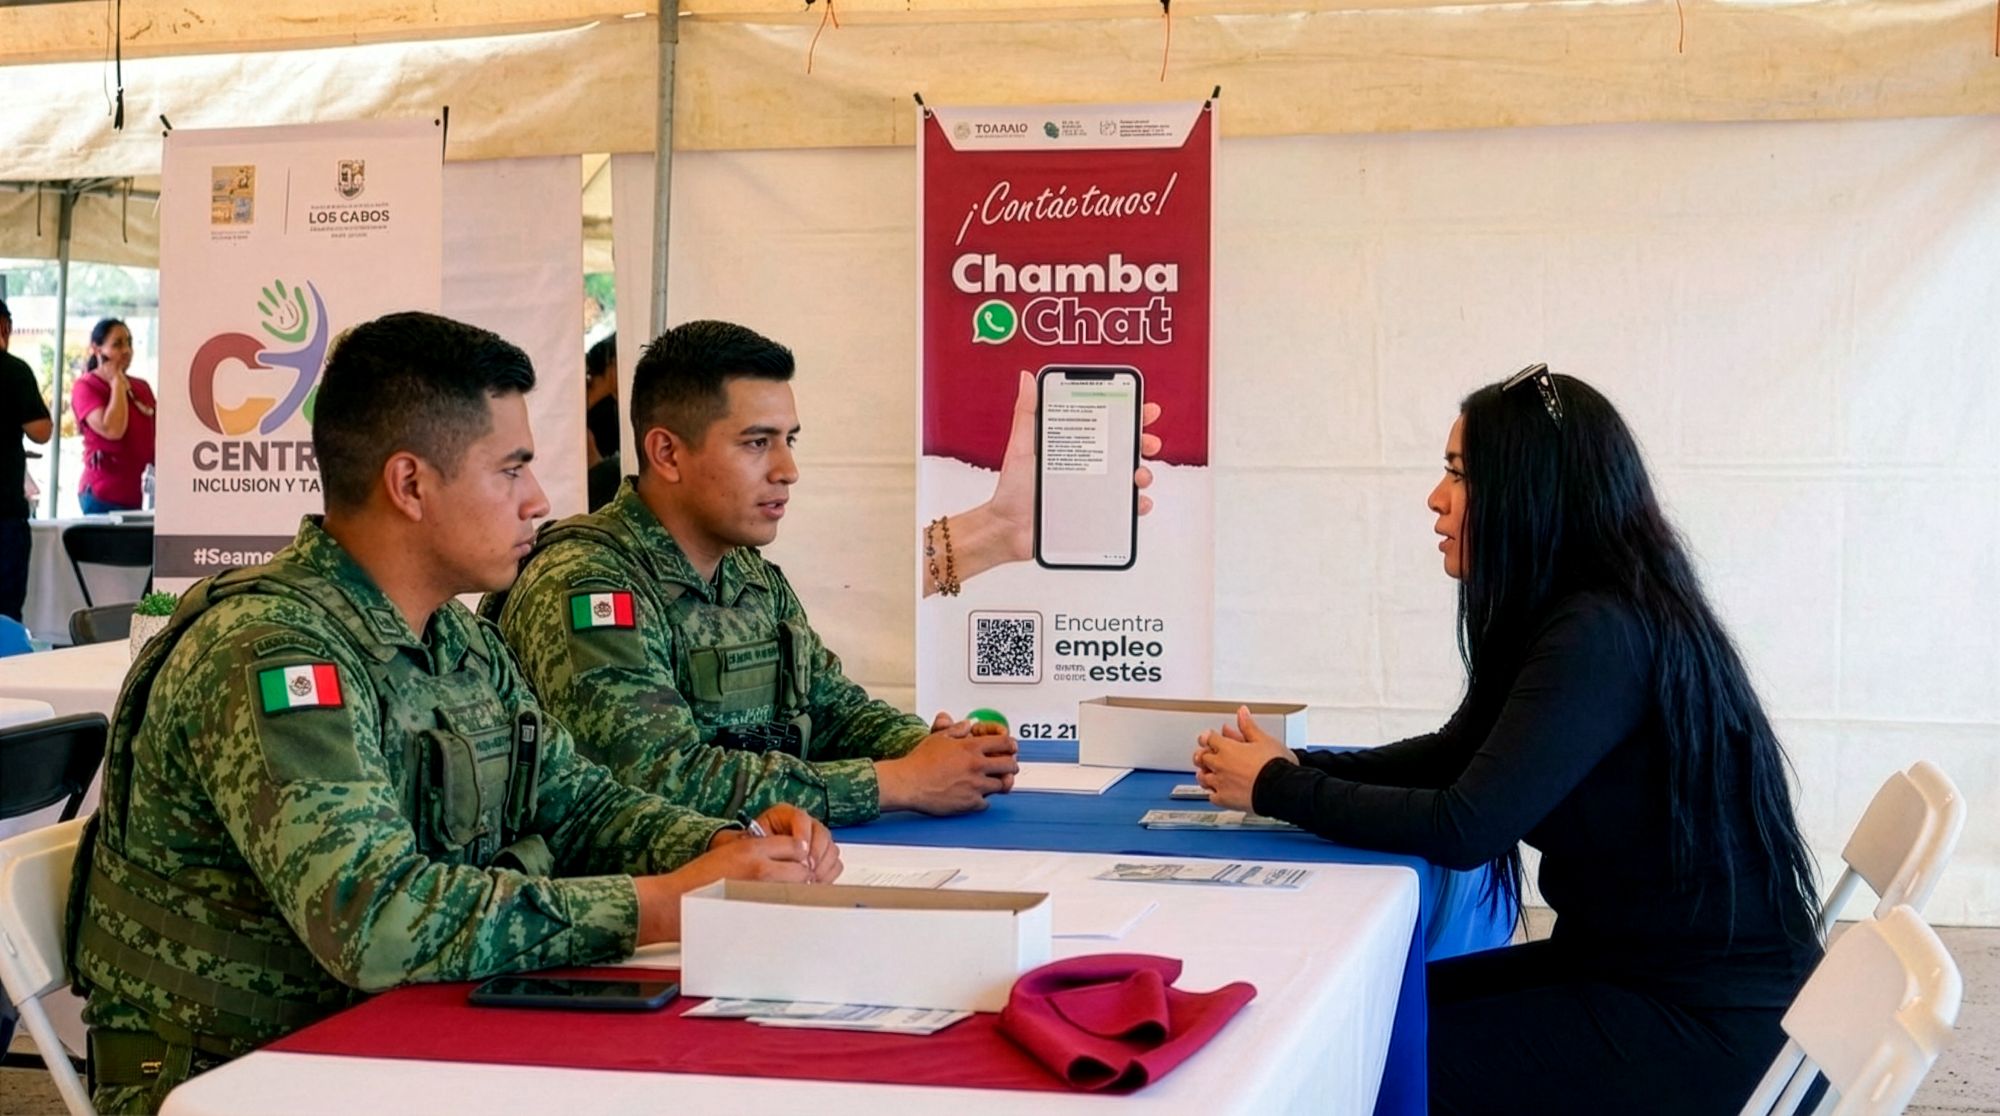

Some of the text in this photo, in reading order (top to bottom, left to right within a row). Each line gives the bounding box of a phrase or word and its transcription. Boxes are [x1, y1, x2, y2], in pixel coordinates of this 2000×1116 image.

[341, 210, 390, 223] CABOS
[955, 172, 1178, 246] ¡Contáctanos!
[952, 254, 1178, 293] Chamba
[1022, 297, 1172, 346] Chat
[192, 442, 317, 471] CENTR
[193, 478, 320, 492] INCLUSION Y TA
[194, 548, 274, 565] #Seame
[1055, 614, 1164, 632] Encuentra
[1055, 636, 1163, 662] empleo
[1089, 660, 1162, 682] estés
[1019, 723, 1077, 739] 612 21
